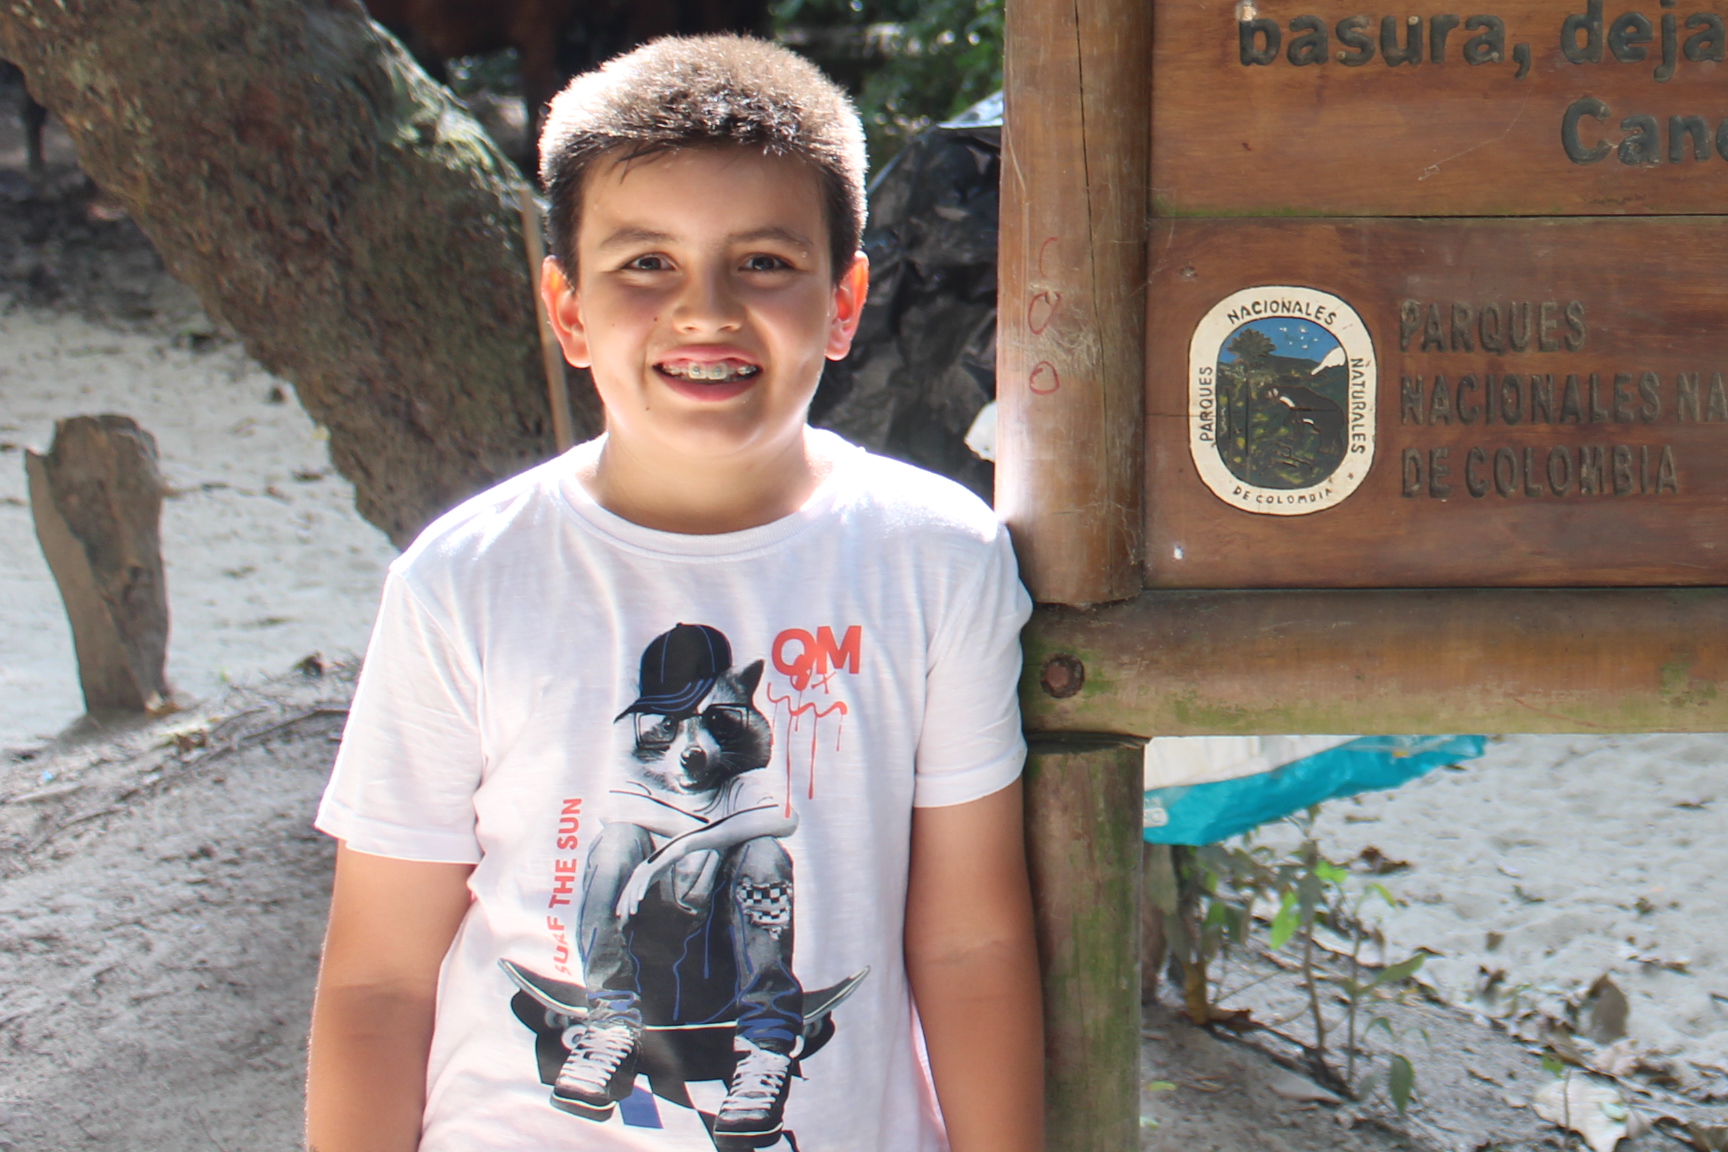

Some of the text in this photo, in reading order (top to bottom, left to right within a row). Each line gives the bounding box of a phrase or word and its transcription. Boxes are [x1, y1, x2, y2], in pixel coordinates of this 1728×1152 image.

[1236, 0, 1532, 81] basura,
[1226, 299, 1337, 325] NACIONALES
[1400, 299, 1587, 354] PARQUES
[1199, 365, 1216, 442] PARQUES
[1350, 358, 1367, 454] NATURALES
[1401, 372, 1662, 426] NACIONALES
[1233, 485, 1251, 501] DE
[1401, 444, 1680, 499] DE COLOMBIA
[772, 625, 862, 690] QM
[556, 798, 582, 850] SUN
[548, 858, 577, 908] THE
